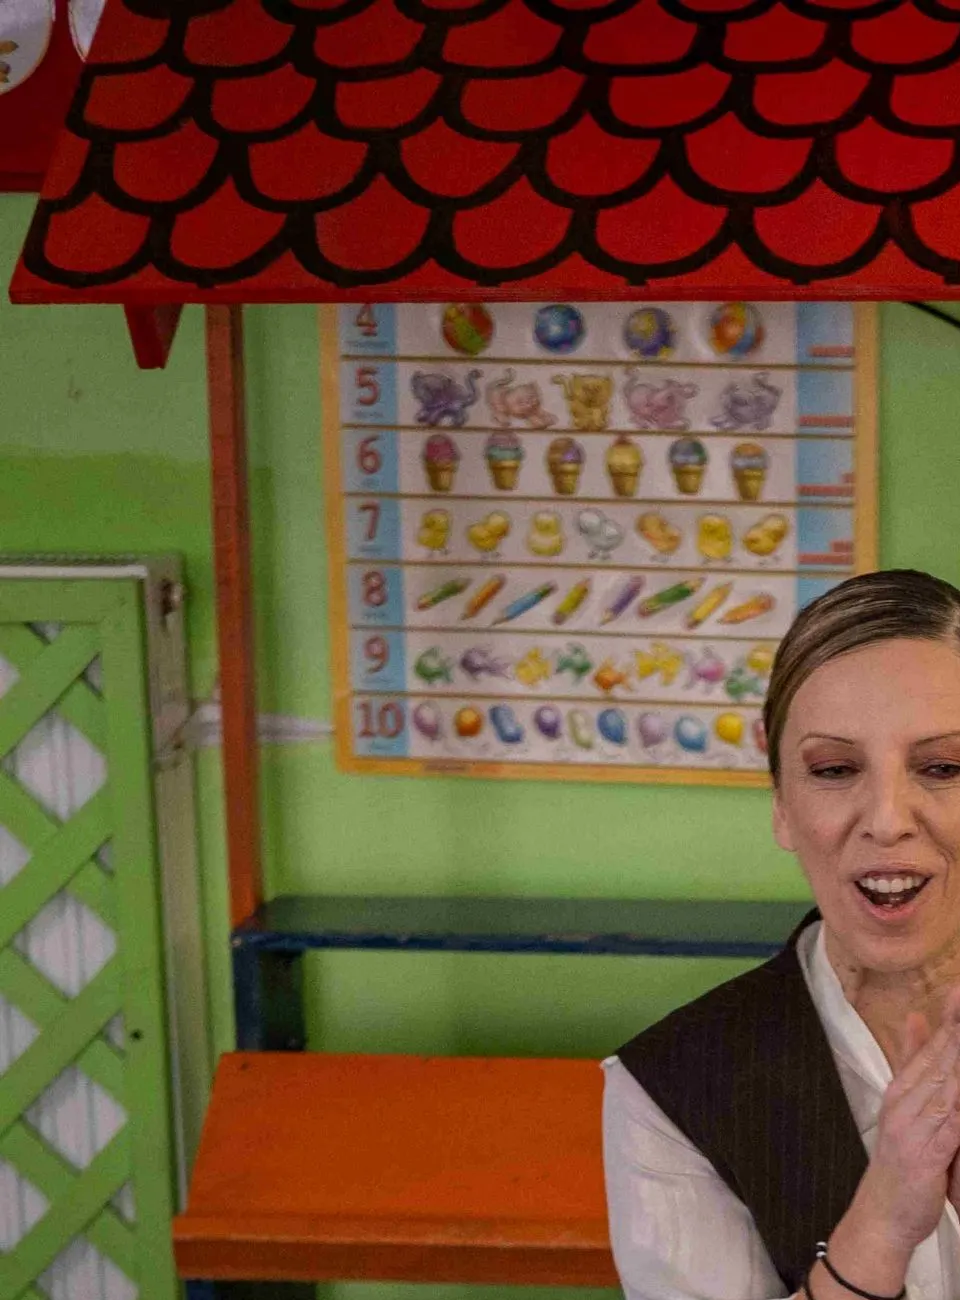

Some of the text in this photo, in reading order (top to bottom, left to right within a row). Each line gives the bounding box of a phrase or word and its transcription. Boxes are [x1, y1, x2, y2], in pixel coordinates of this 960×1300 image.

[355, 367, 380, 406] 5
[356, 435, 381, 475] 6
[358, 501, 380, 541] 7
[362, 570, 387, 609] 8
[363, 635, 390, 674] 9
[358, 701, 405, 738] 10
